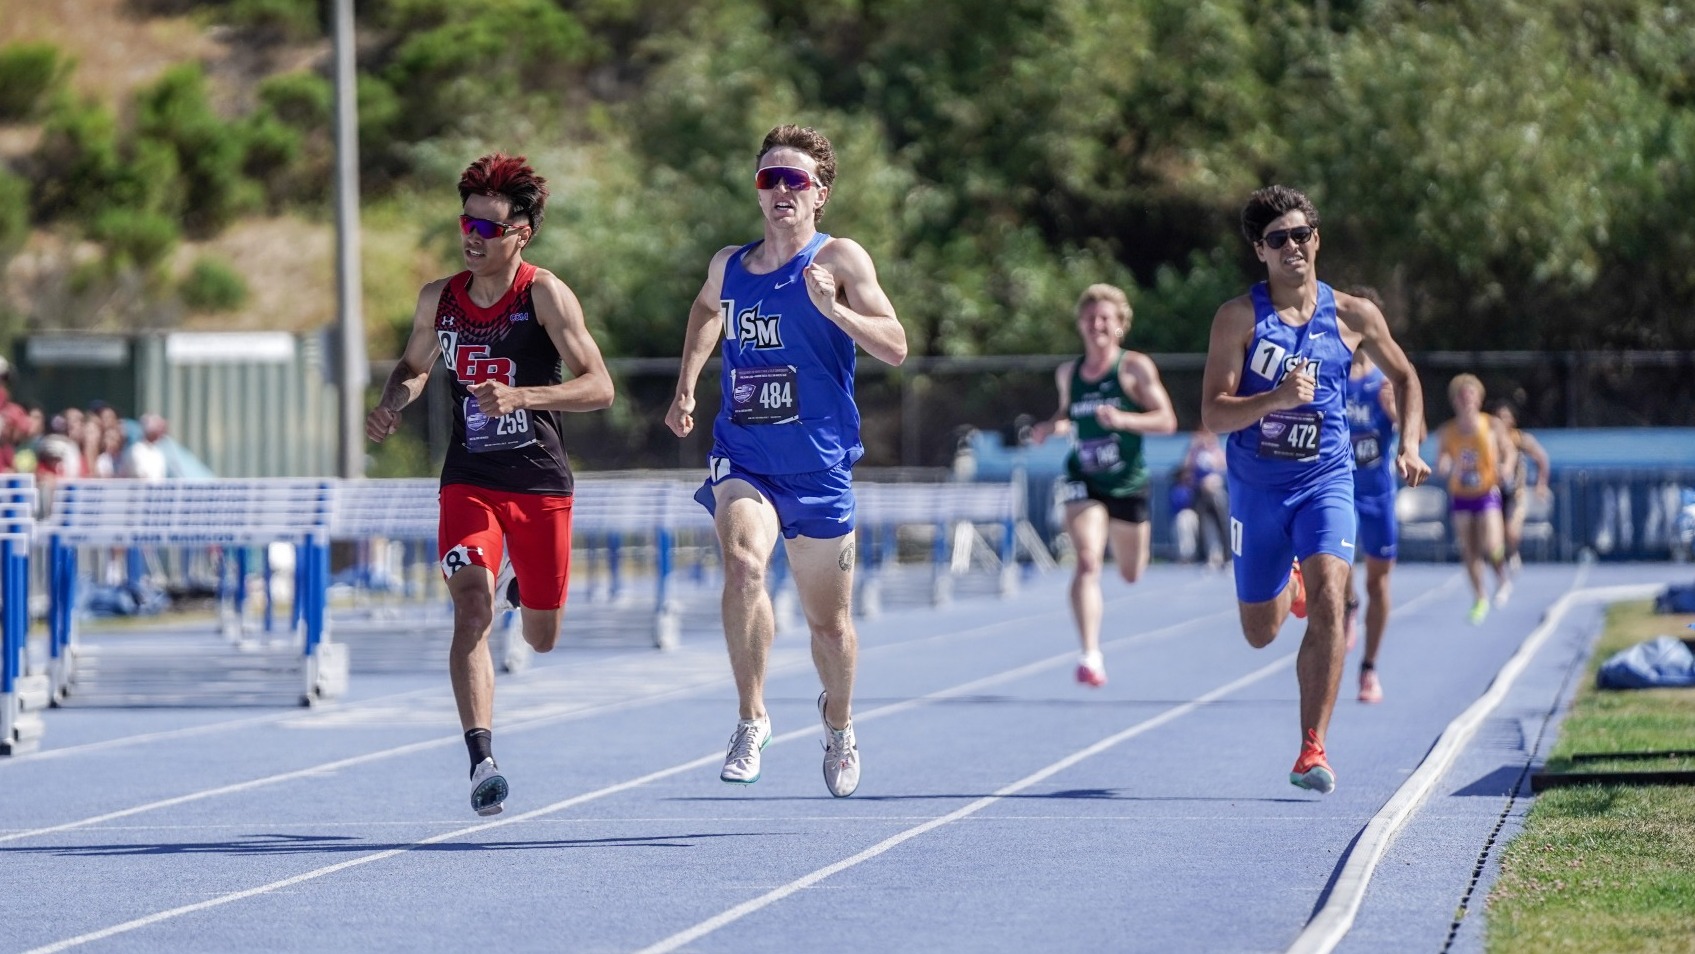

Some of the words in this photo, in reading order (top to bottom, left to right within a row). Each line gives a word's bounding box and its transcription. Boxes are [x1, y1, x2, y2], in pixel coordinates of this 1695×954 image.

[737, 300, 785, 353] SM
[441, 332, 453, 368] 8
[1261, 346, 1276, 375] 1
[456, 344, 517, 388] EB
[759, 382, 793, 409] 484
[495, 409, 529, 436] 259
[1287, 424, 1318, 449] 472
[446, 550, 467, 575] 8
